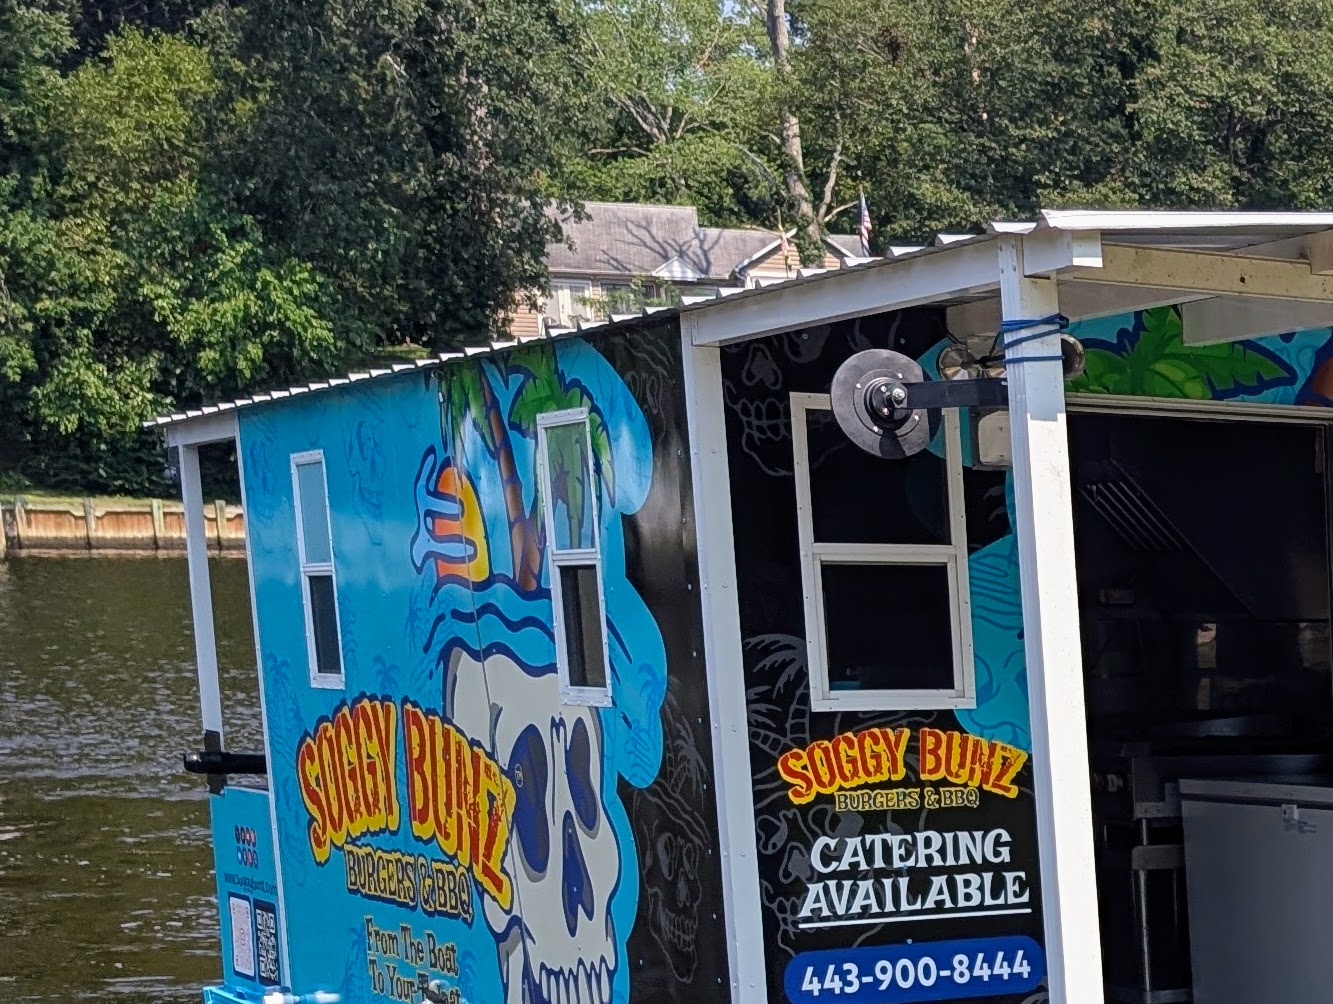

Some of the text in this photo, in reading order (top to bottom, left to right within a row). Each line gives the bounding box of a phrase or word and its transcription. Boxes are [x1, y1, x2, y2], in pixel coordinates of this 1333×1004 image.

[778, 727, 1028, 804] SOGGY BUNZ
[296, 697, 517, 911] SOGGY BUNZ
[835, 786, 980, 812] BURGERS & BBQ
[810, 828, 1012, 874] CATERING
[344, 843, 473, 921] BURGERS & BBQ
[797, 871, 1030, 918] AVAILABLE
[365, 914, 460, 977] From The Boat
[368, 955, 385, 995] To
[801, 950, 1031, 996] 443-900-8444
